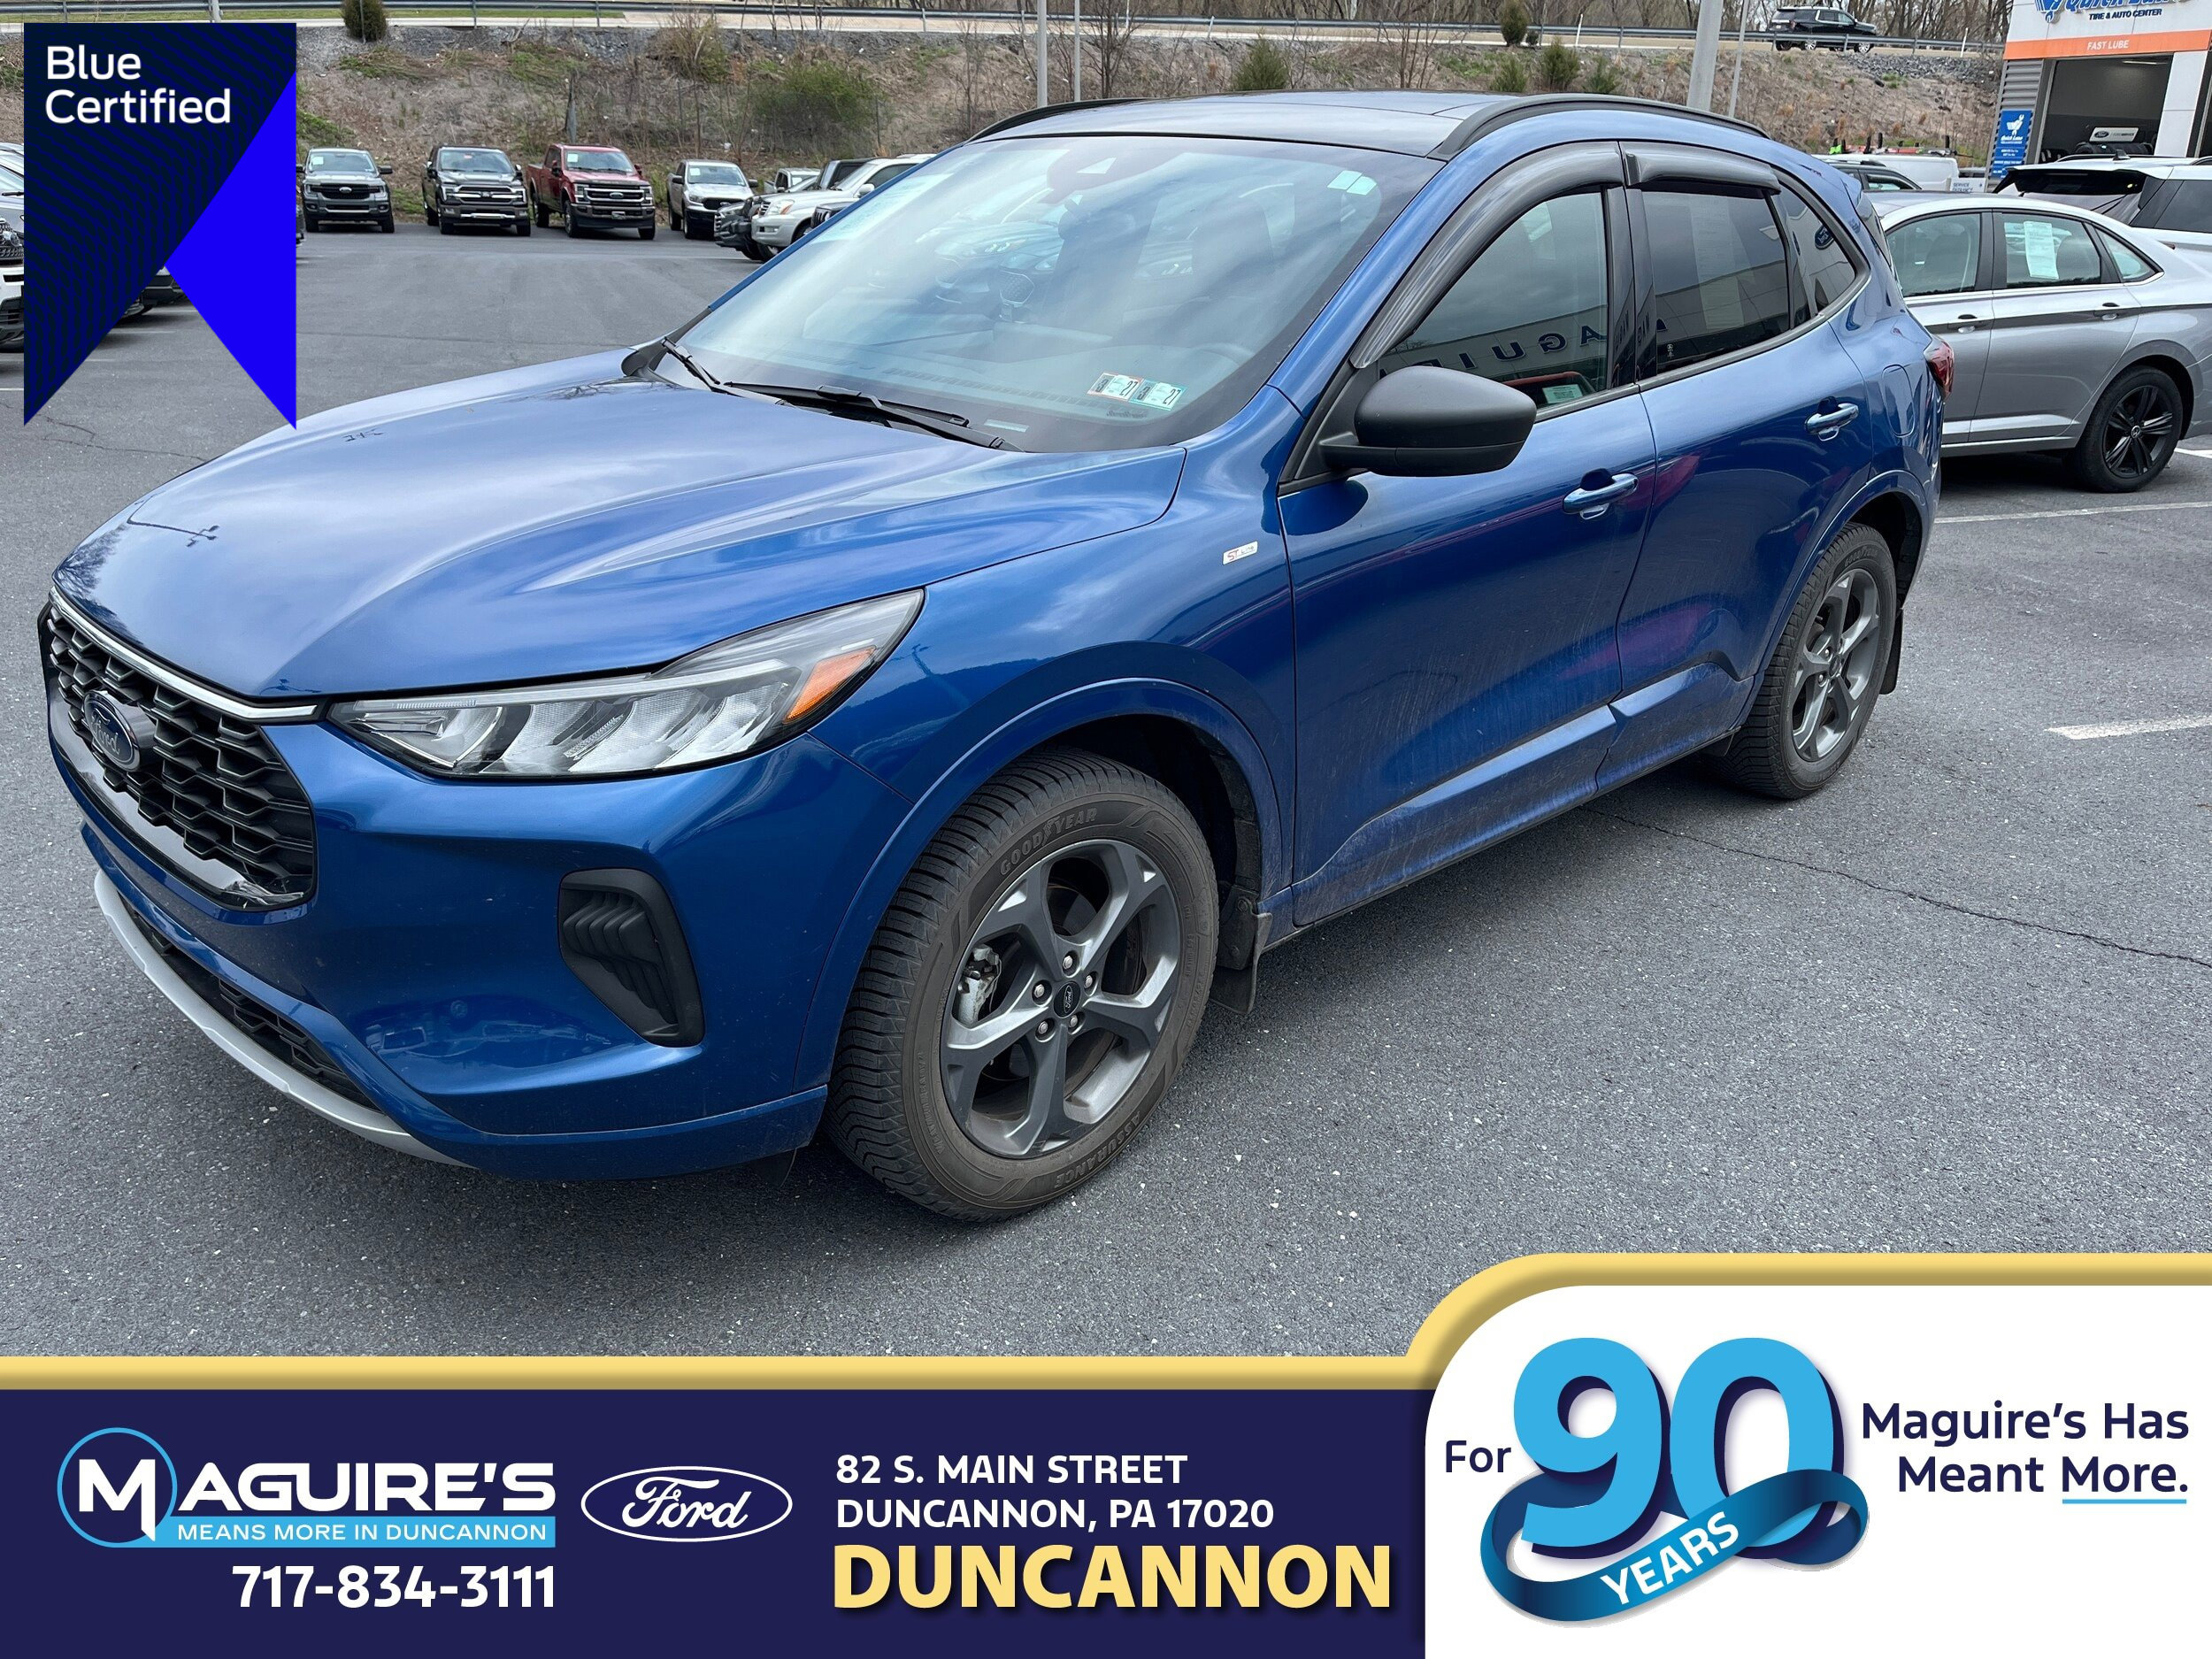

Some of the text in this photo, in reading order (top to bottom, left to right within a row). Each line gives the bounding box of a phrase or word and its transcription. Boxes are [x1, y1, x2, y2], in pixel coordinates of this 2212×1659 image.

[2112, 10, 2131, 19] AUTO
[2132, 8, 2162, 18] CENTER
[2087, 39, 2130, 50] FAST LUBE
[1119, 380, 1138, 398] 27
[1162, 388, 1181, 405] 27
[90, 707, 120, 755] Ford
[1054, 1110, 1141, 1189] ASSURANCE
